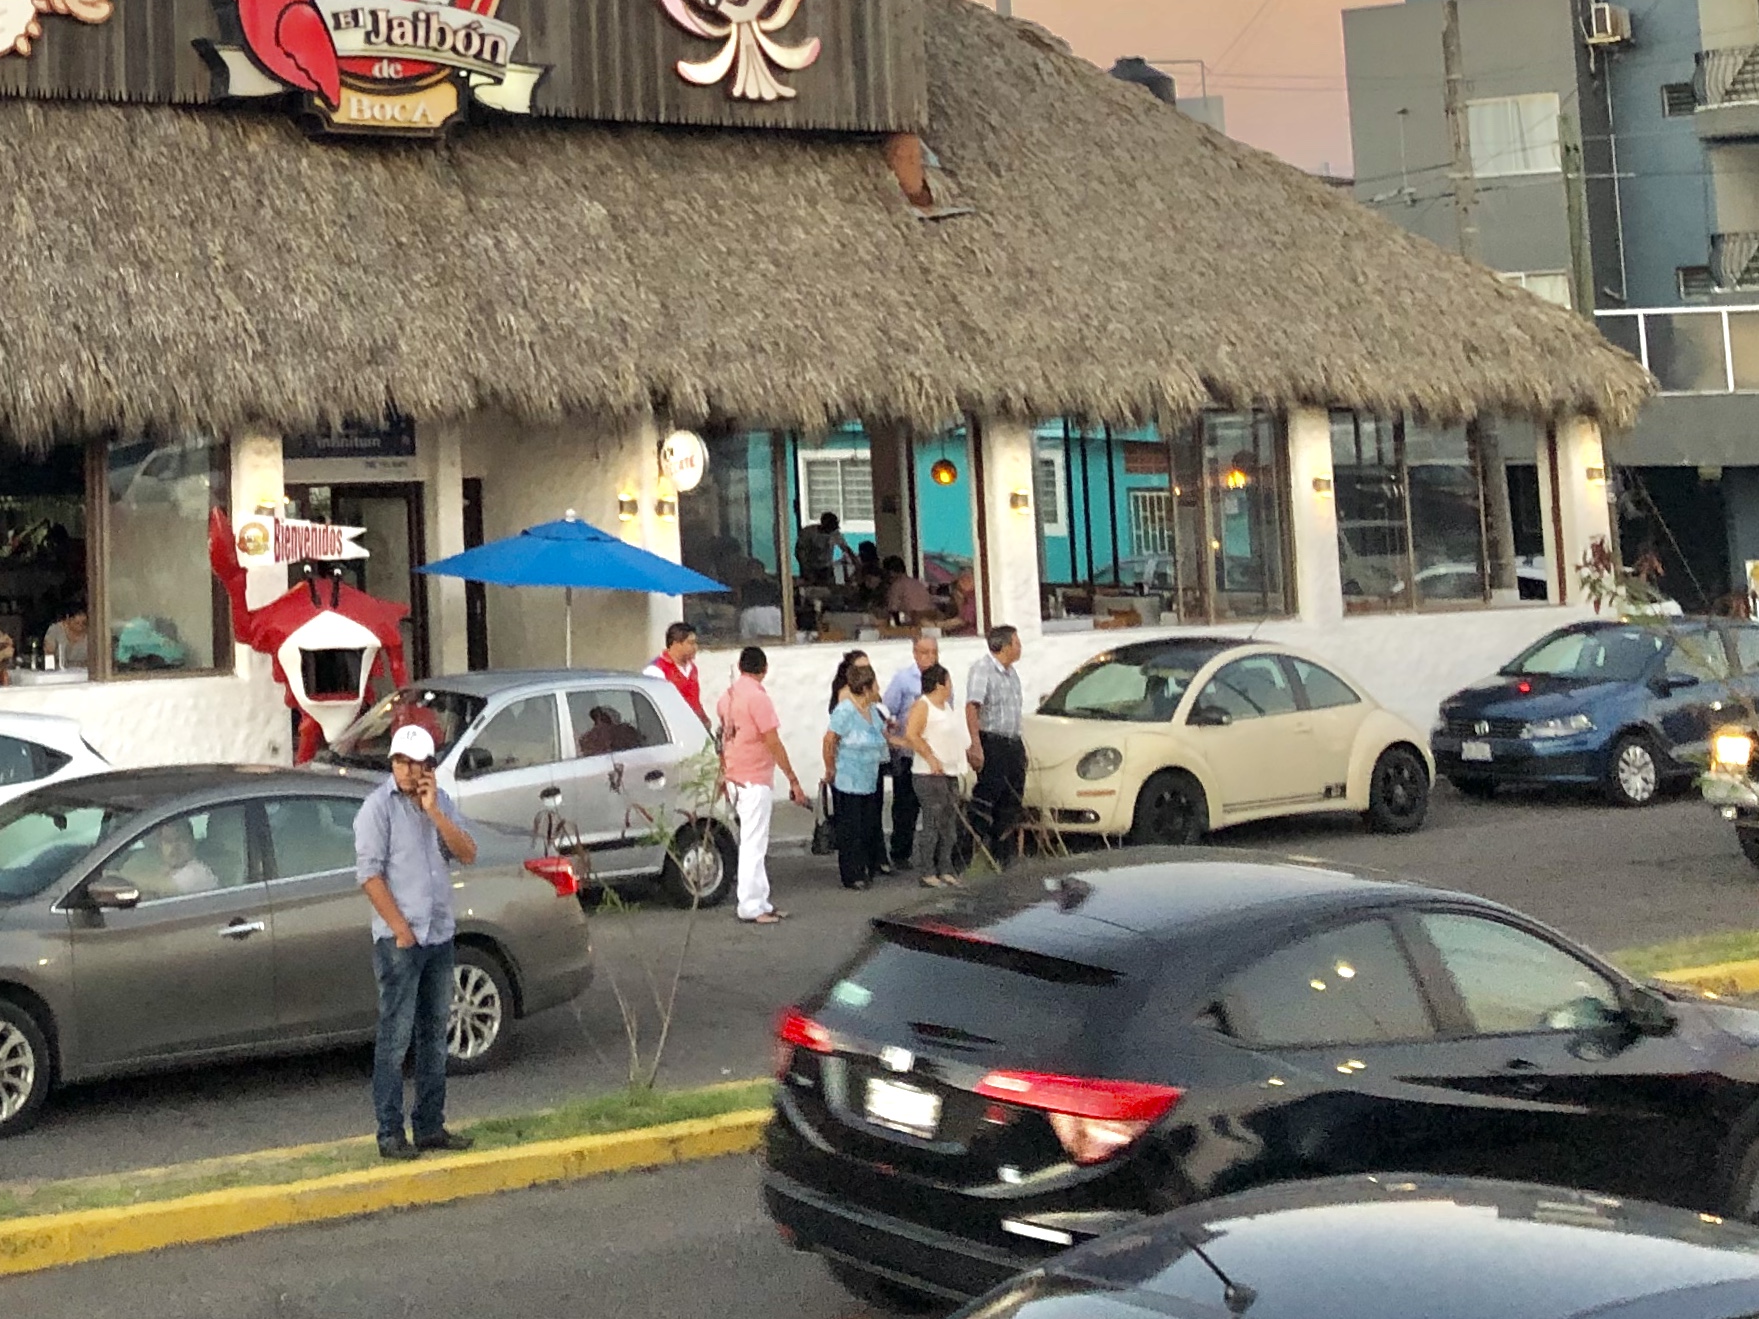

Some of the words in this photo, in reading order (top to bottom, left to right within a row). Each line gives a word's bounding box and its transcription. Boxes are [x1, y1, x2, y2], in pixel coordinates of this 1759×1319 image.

[332, 7, 364, 30] El
[365, 8, 510, 66] Jaibón
[371, 58, 403, 79] de
[274, 516, 343, 563] Bienvenidos
